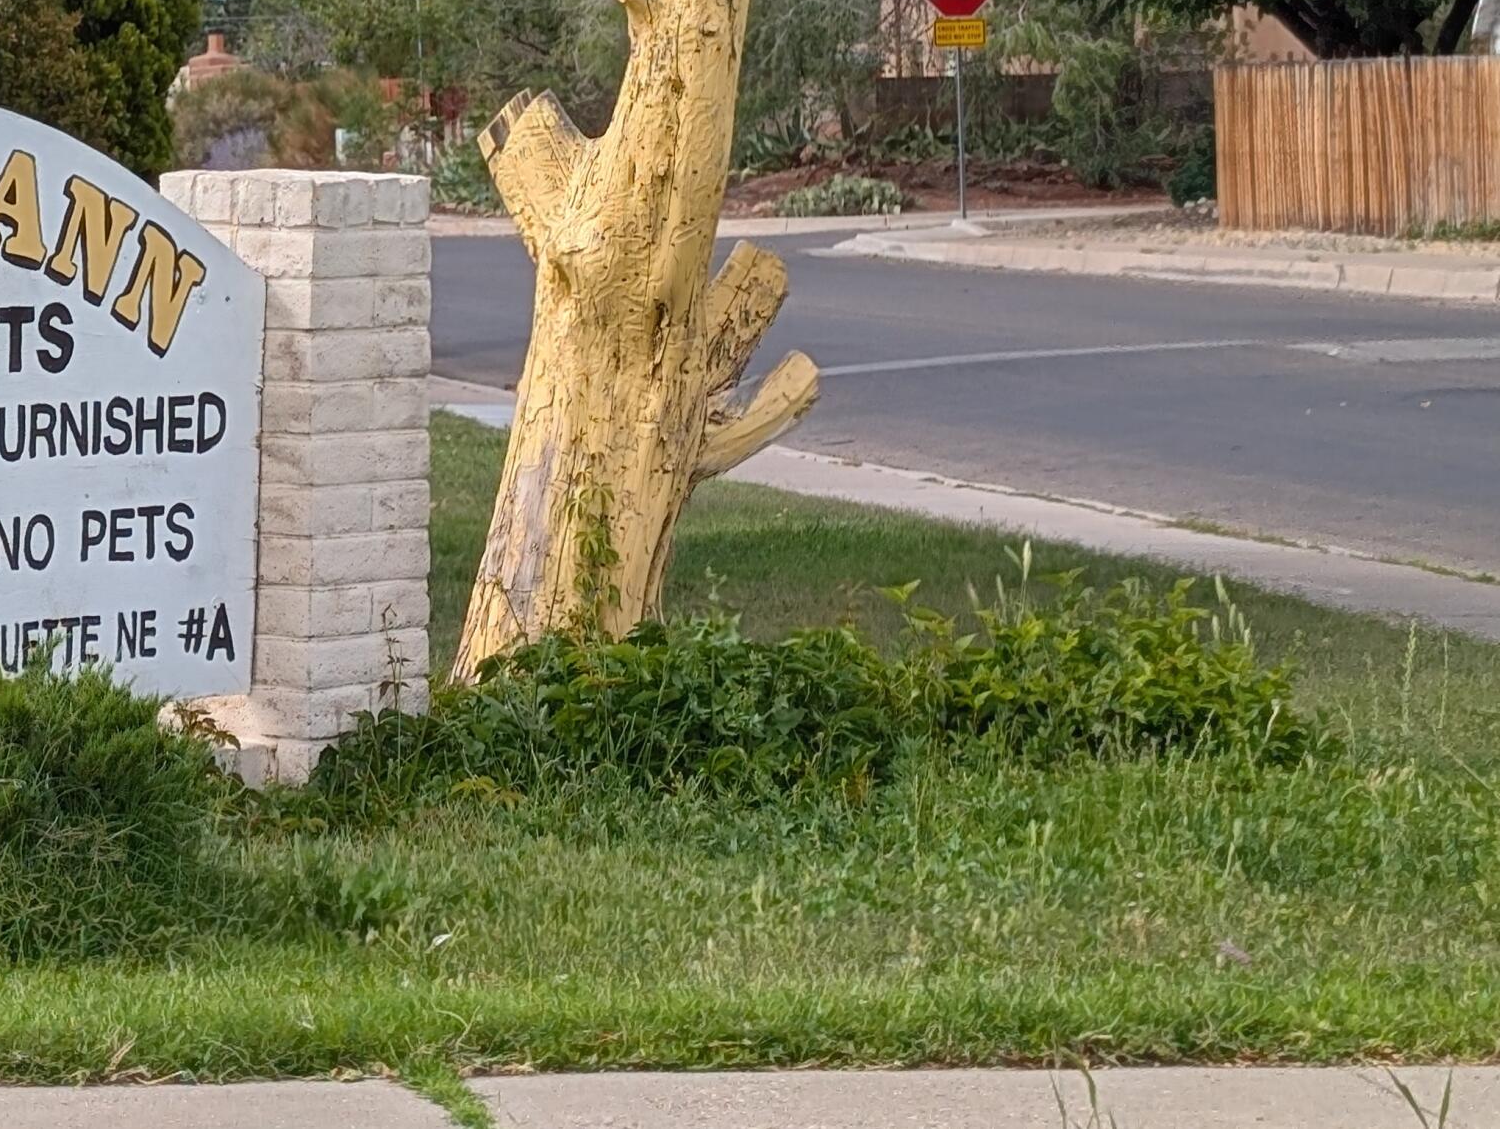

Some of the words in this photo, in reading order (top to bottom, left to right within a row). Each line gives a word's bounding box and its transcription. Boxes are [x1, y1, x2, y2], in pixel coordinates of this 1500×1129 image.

[80, 502, 195, 562] PETS
[115, 610, 157, 662] NE
[179, 602, 235, 662] #A
